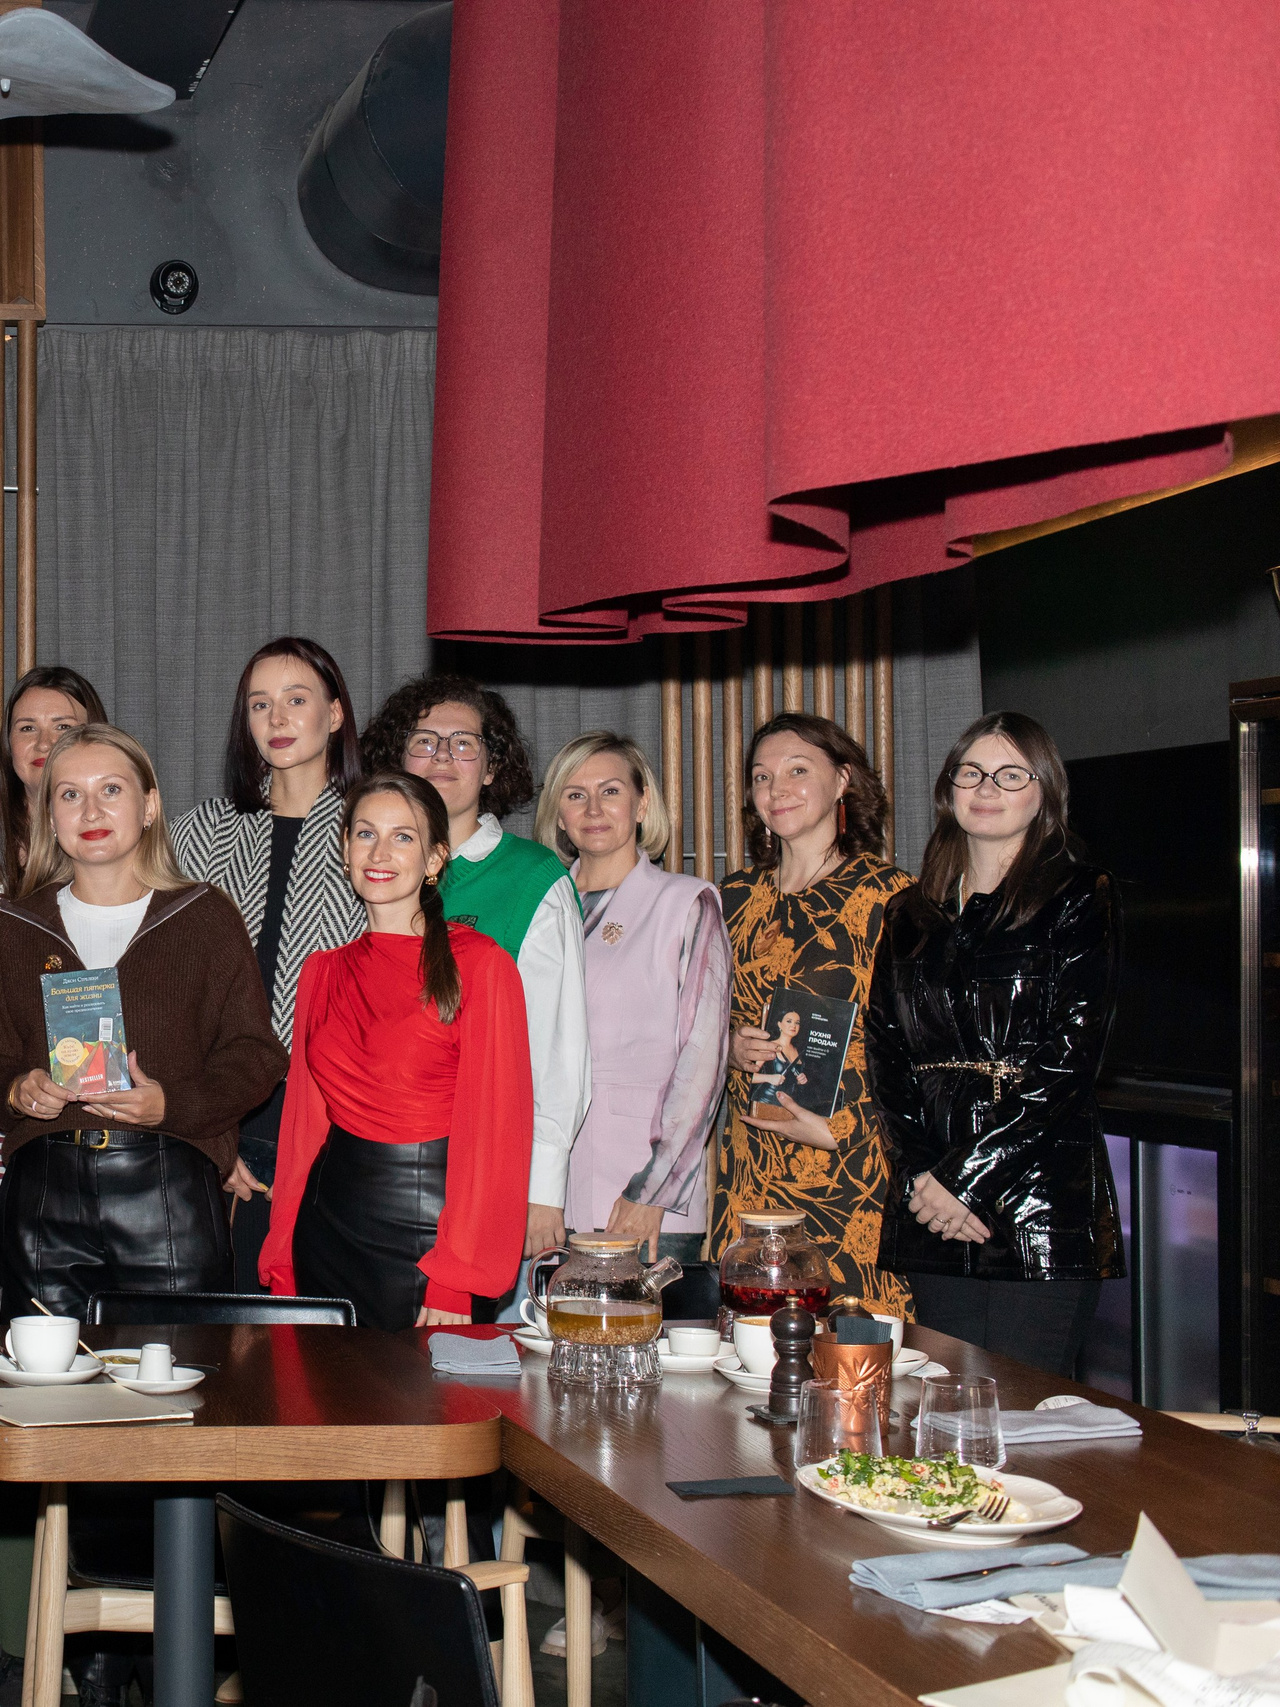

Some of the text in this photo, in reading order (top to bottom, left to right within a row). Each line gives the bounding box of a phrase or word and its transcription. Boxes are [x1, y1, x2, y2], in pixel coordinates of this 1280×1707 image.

[50, 986, 83, 996] Большая
[810, 1030, 832, 1040] КУХНЯ
[808, 1036, 838, 1048] ПРОДАЖ
